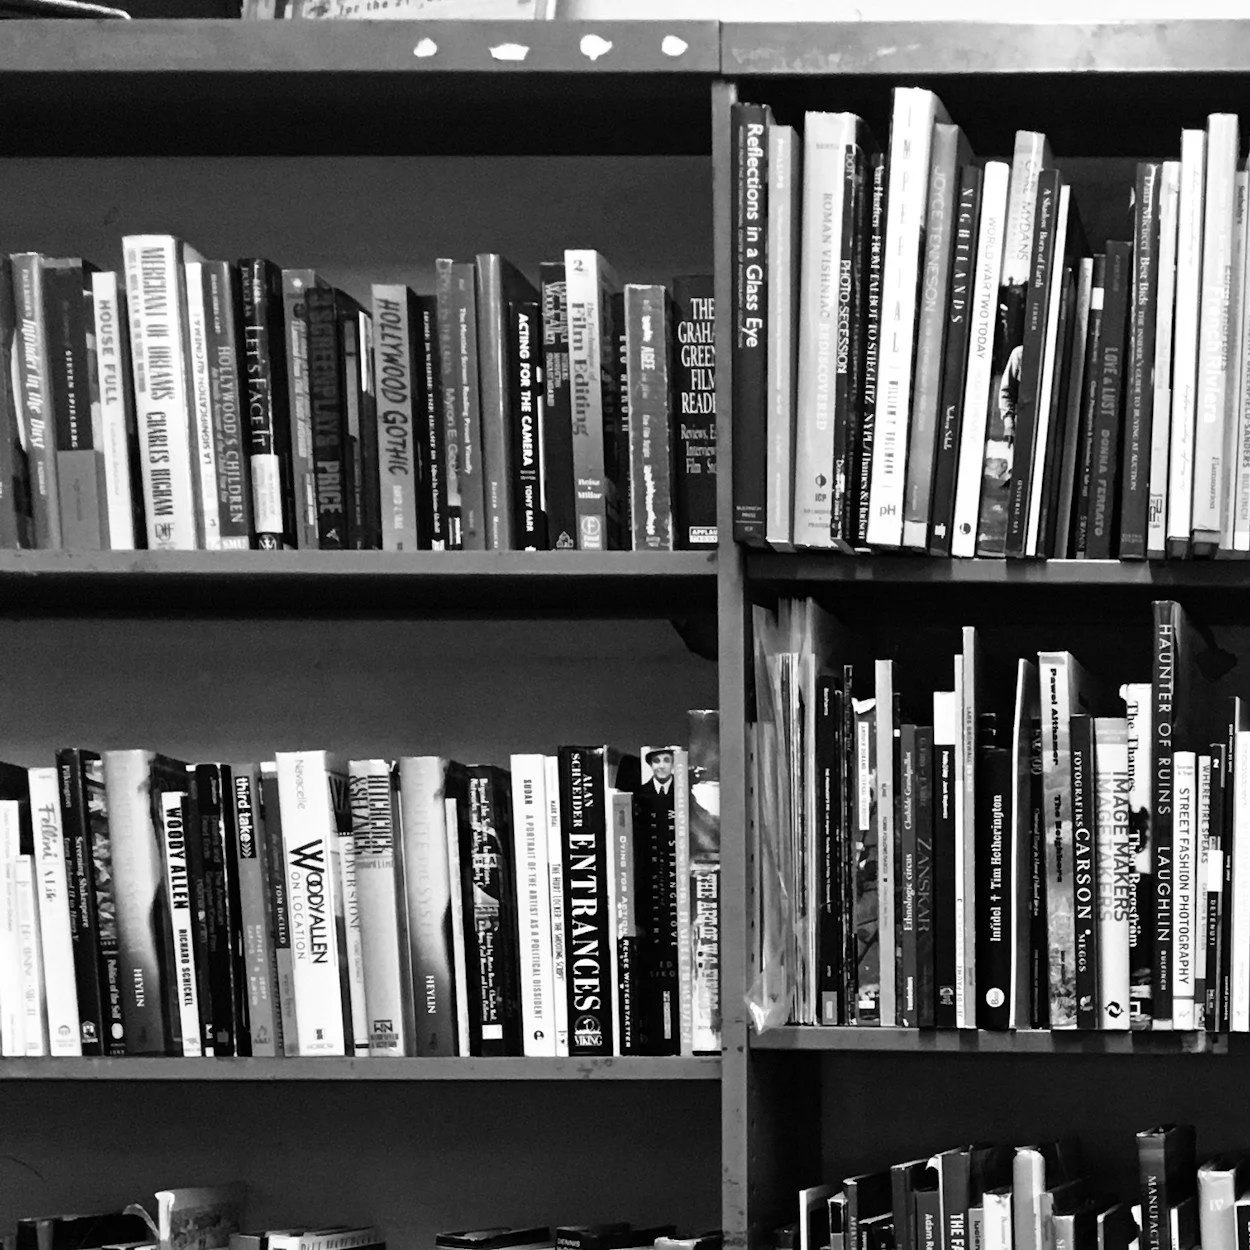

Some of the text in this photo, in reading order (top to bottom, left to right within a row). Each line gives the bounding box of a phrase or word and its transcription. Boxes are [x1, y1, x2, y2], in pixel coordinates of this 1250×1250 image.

[743, 123, 764, 348] Reflections in a Glass Eye
[99, 300, 117, 405] HOUSE FULL
[378, 300, 409, 475] HOLLYWOOD GOTHIC
[518, 313, 535, 466] ACTING FOR THE CAMERA
[146, 411, 173, 516] CHARLES HIGHAM
[236, 777, 251, 842] third take
[571, 753, 593, 827] ALAN SCHNEIDER
[1157, 624, 1171, 941] HAUNTER OF RUINS LAUGHLIN
[166, 808, 188, 909] WOODY ALLEN
[1075, 828, 1092, 919] CARSON
[1178, 787, 1190, 984] STREET FASHION PHOTOGRAPHY
[569, 833, 600, 1011] ENTRANCES
[950, 1213, 965, 1234] THE
